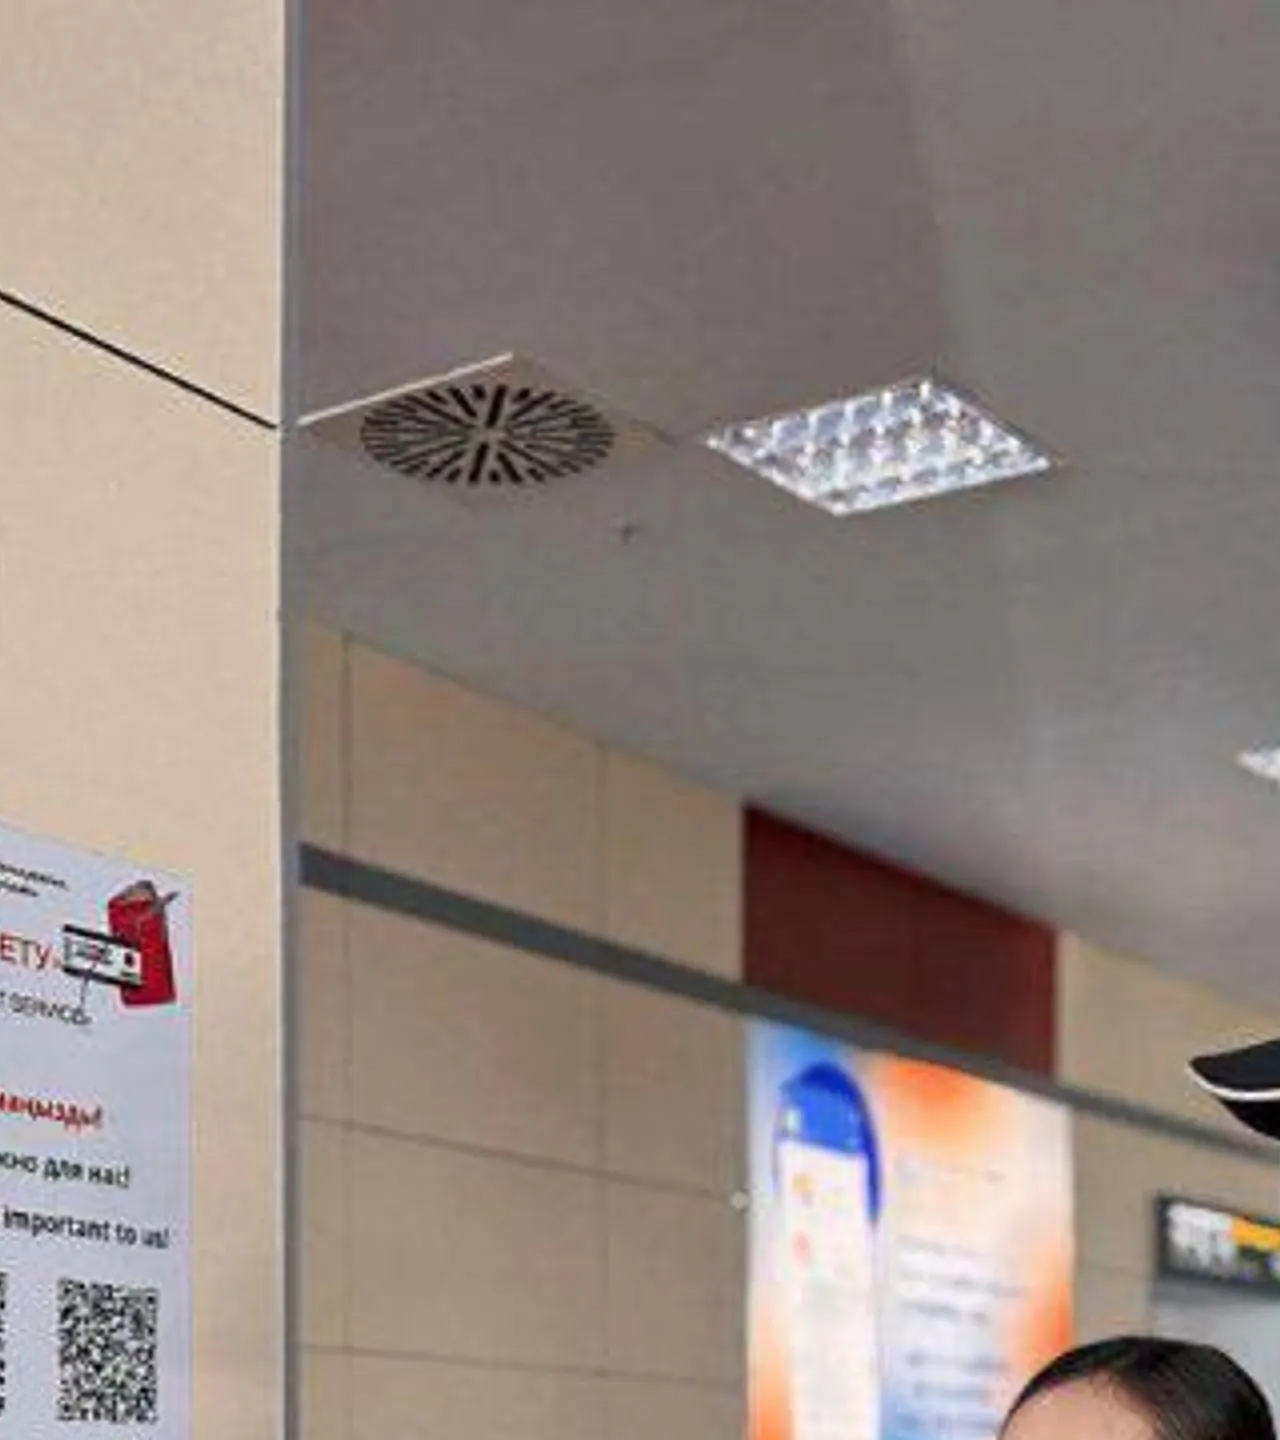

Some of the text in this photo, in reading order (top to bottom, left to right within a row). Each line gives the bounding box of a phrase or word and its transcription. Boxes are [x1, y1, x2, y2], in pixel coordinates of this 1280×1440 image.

[43, 1156, 83, 1181] для
[87, 1165, 131, 1189] нас!
[3, 1204, 111, 1241] important
[115, 1222, 137, 1246] to
[140, 1225, 170, 1249] us!
